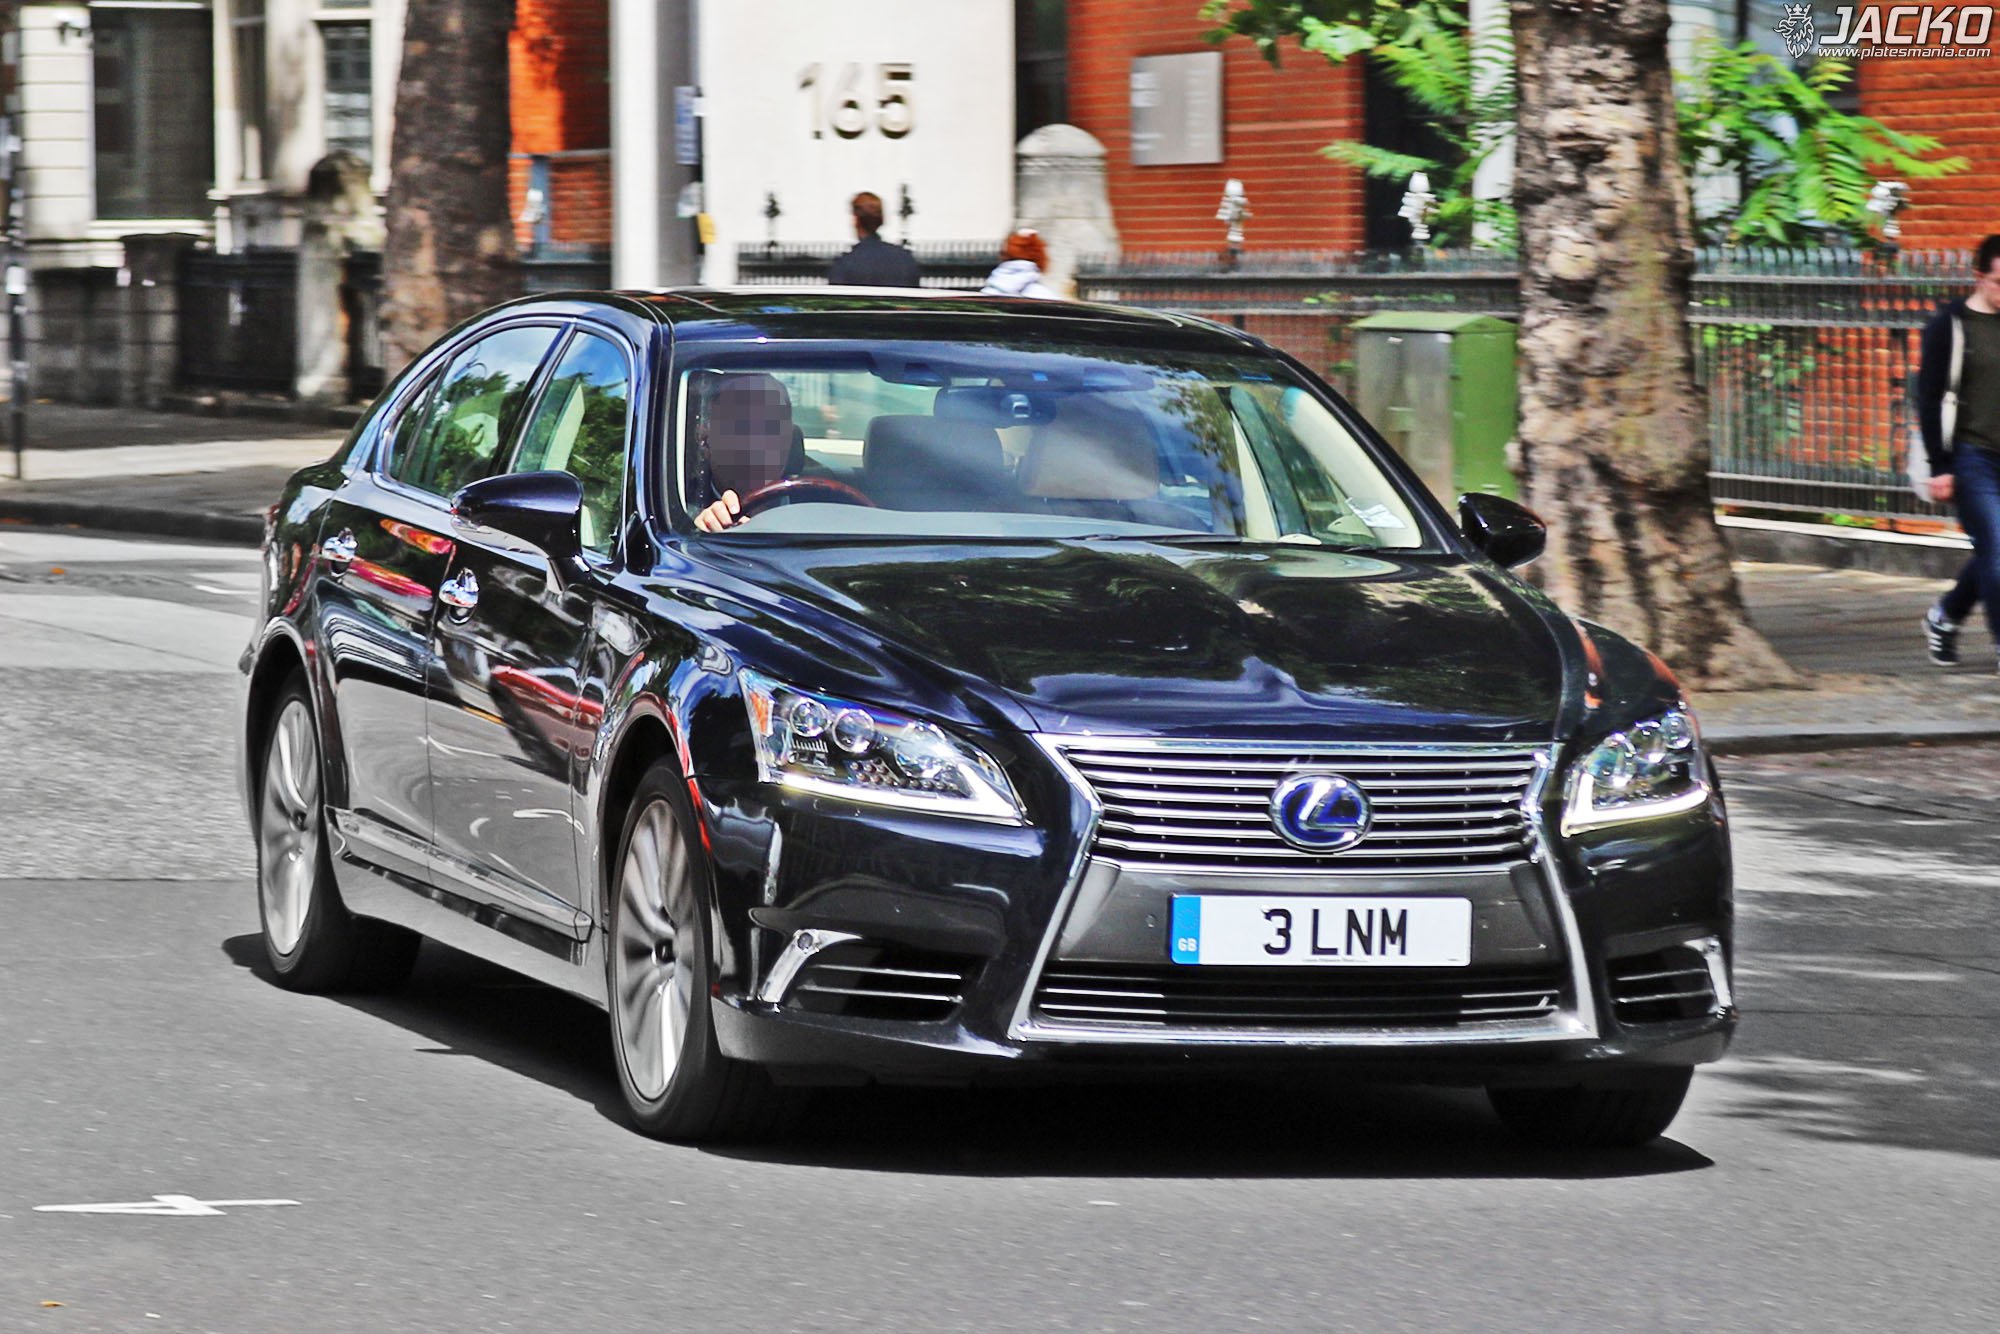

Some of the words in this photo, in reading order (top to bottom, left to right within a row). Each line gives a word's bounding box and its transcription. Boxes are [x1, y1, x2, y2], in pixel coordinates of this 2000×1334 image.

[799, 62, 914, 139] 165
[1178, 937, 1198, 952] GB
[1262, 908, 1292, 955] 3
[1311, 908, 1408, 956] LNM
